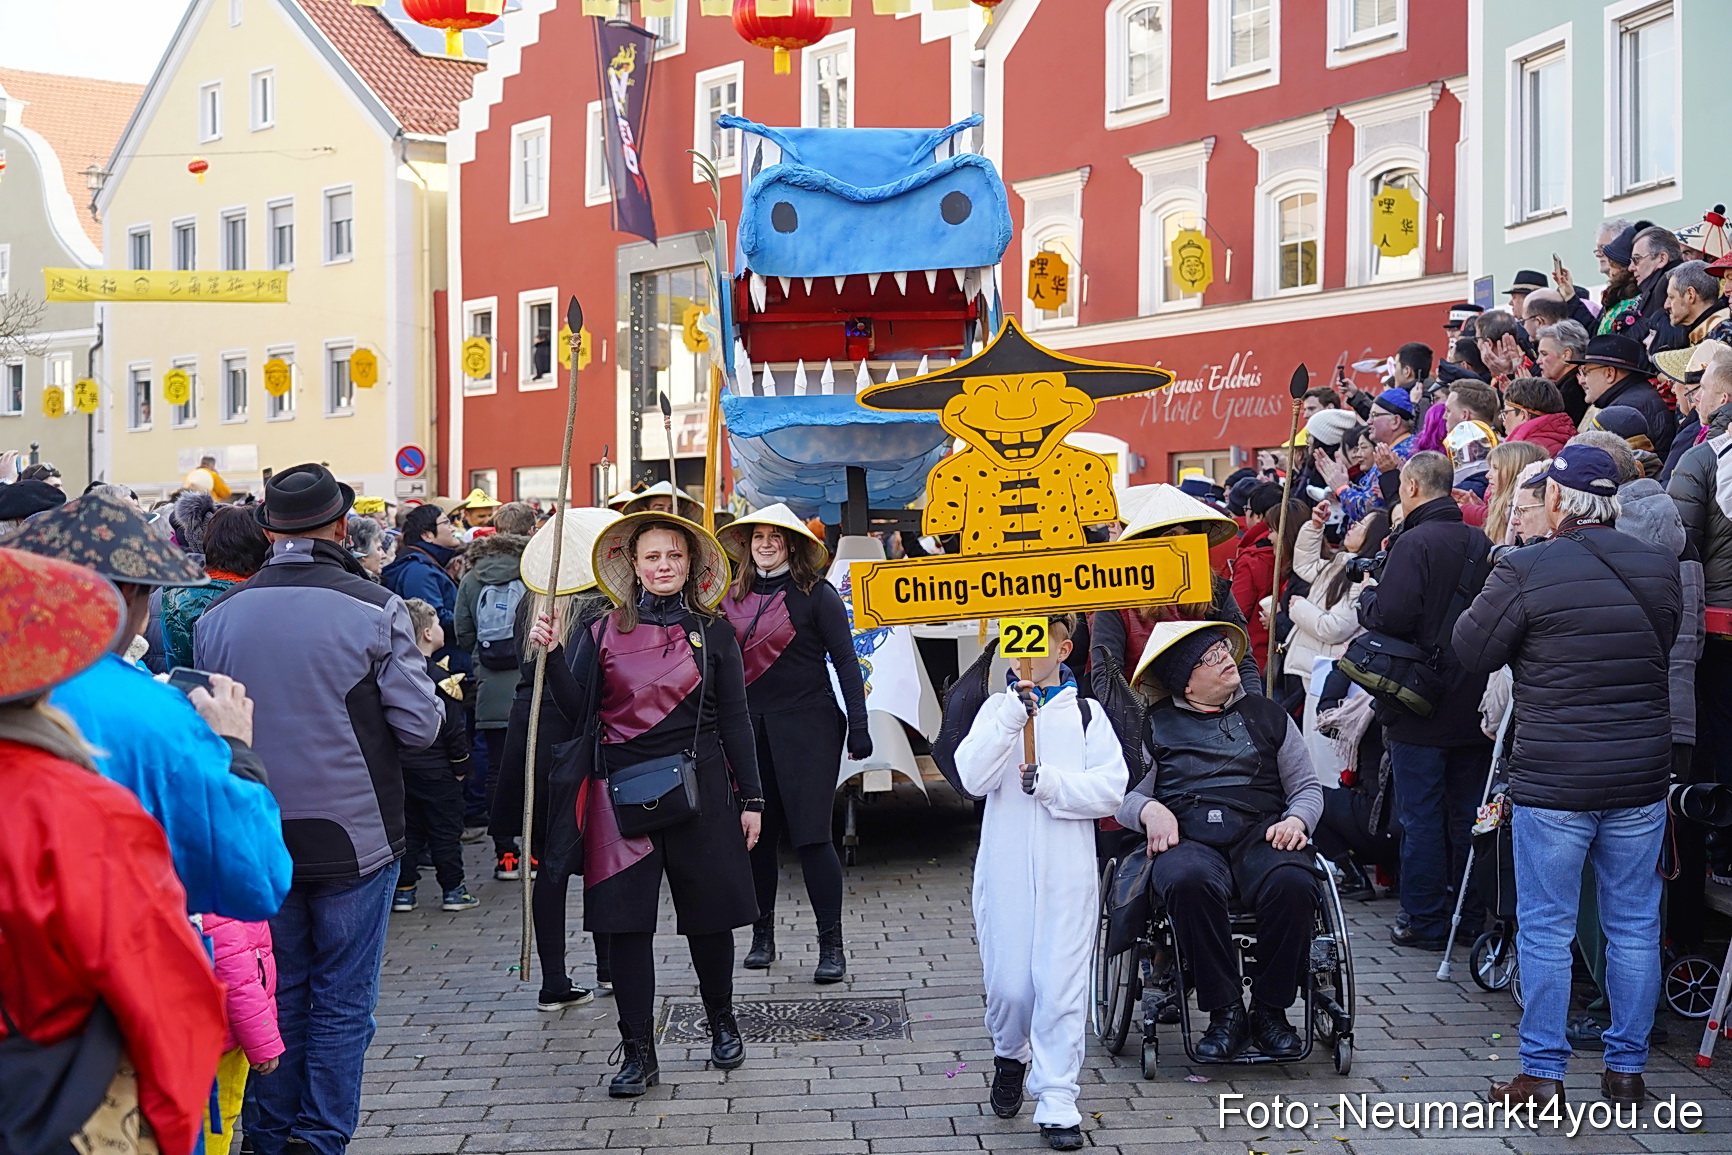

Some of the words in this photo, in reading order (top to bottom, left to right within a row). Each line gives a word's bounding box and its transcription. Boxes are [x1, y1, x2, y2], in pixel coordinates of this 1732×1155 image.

[1208, 350, 1263, 392] Erlebnis
[1212, 386, 1285, 440] Genuss
[1576, 518, 1601, 526] Canon
[894, 562, 1155, 606] Ching-Chang-Chung
[1003, 624, 1046, 654] 22
